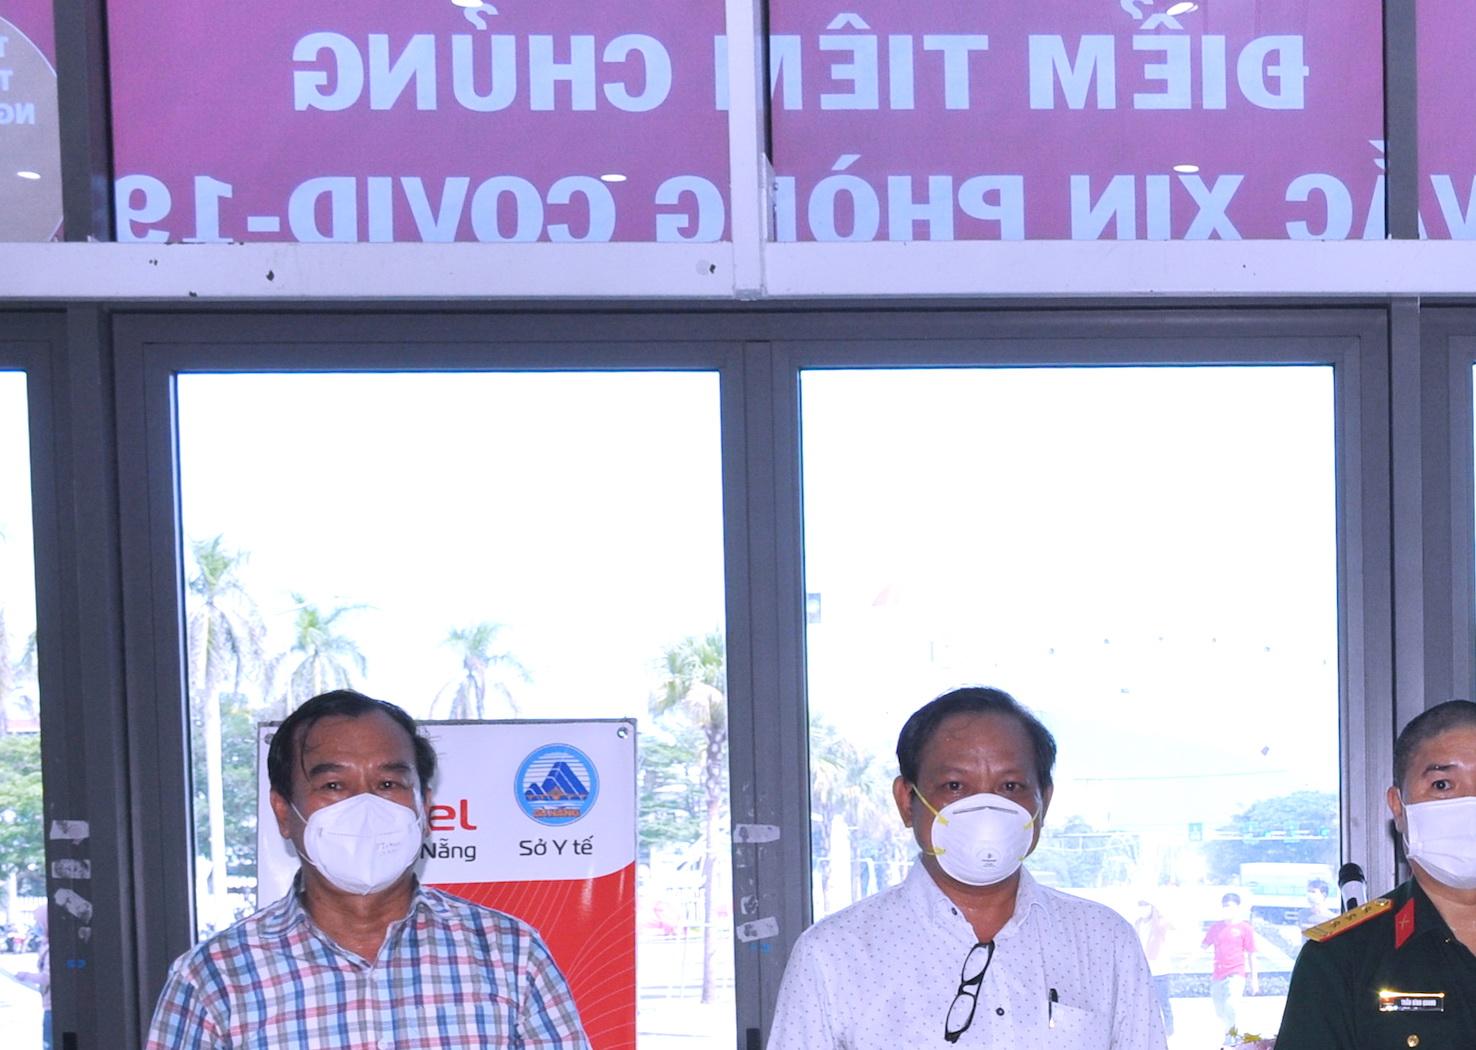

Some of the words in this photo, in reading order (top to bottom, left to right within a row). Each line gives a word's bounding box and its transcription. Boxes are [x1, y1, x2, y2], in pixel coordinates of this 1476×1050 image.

[420, 838, 476, 863] Nẵng
[519, 838, 547, 857] Sở
[552, 839, 568, 856] Y
[572, 835, 594, 856] tế
